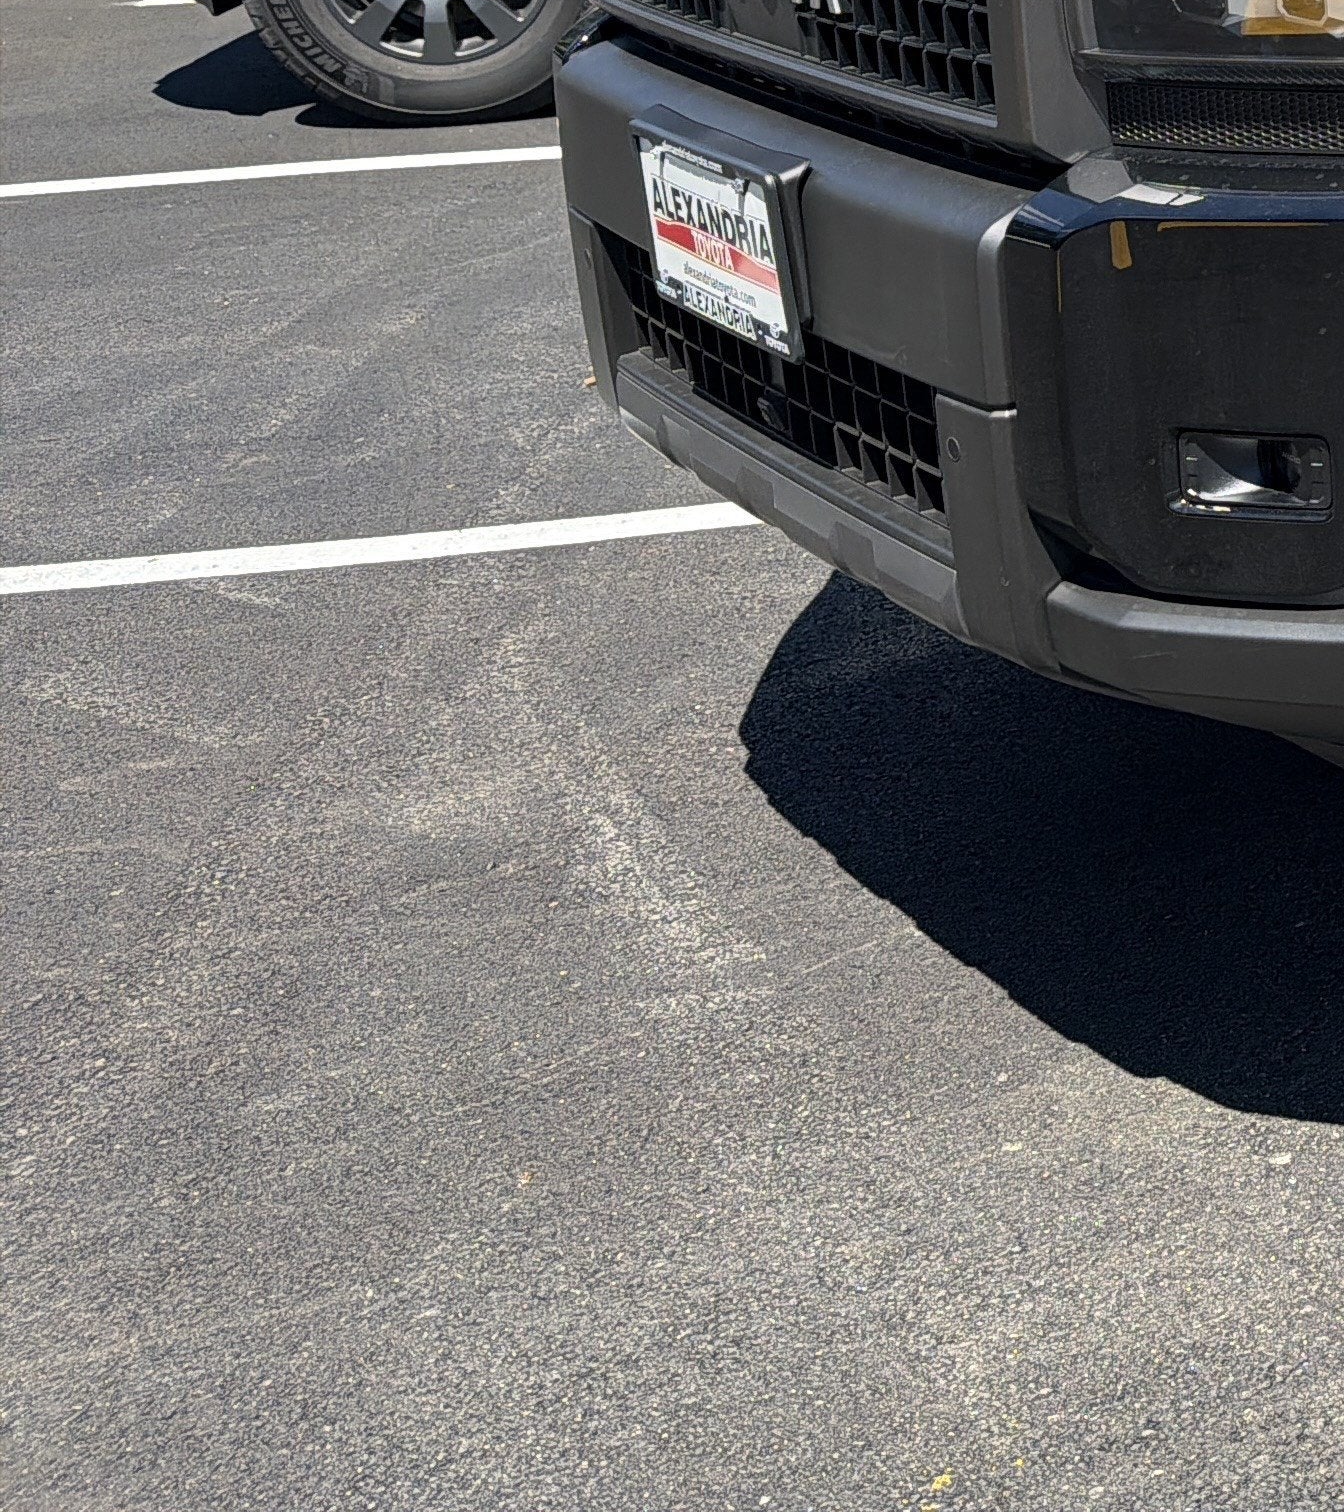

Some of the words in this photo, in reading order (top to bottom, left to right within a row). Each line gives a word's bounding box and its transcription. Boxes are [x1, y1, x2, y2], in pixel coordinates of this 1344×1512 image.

[652, 177, 776, 266] ALEXANDRIA
[690, 228, 734, 272] TOYOTA
[683, 283, 757, 341] ALEXANDRIA
